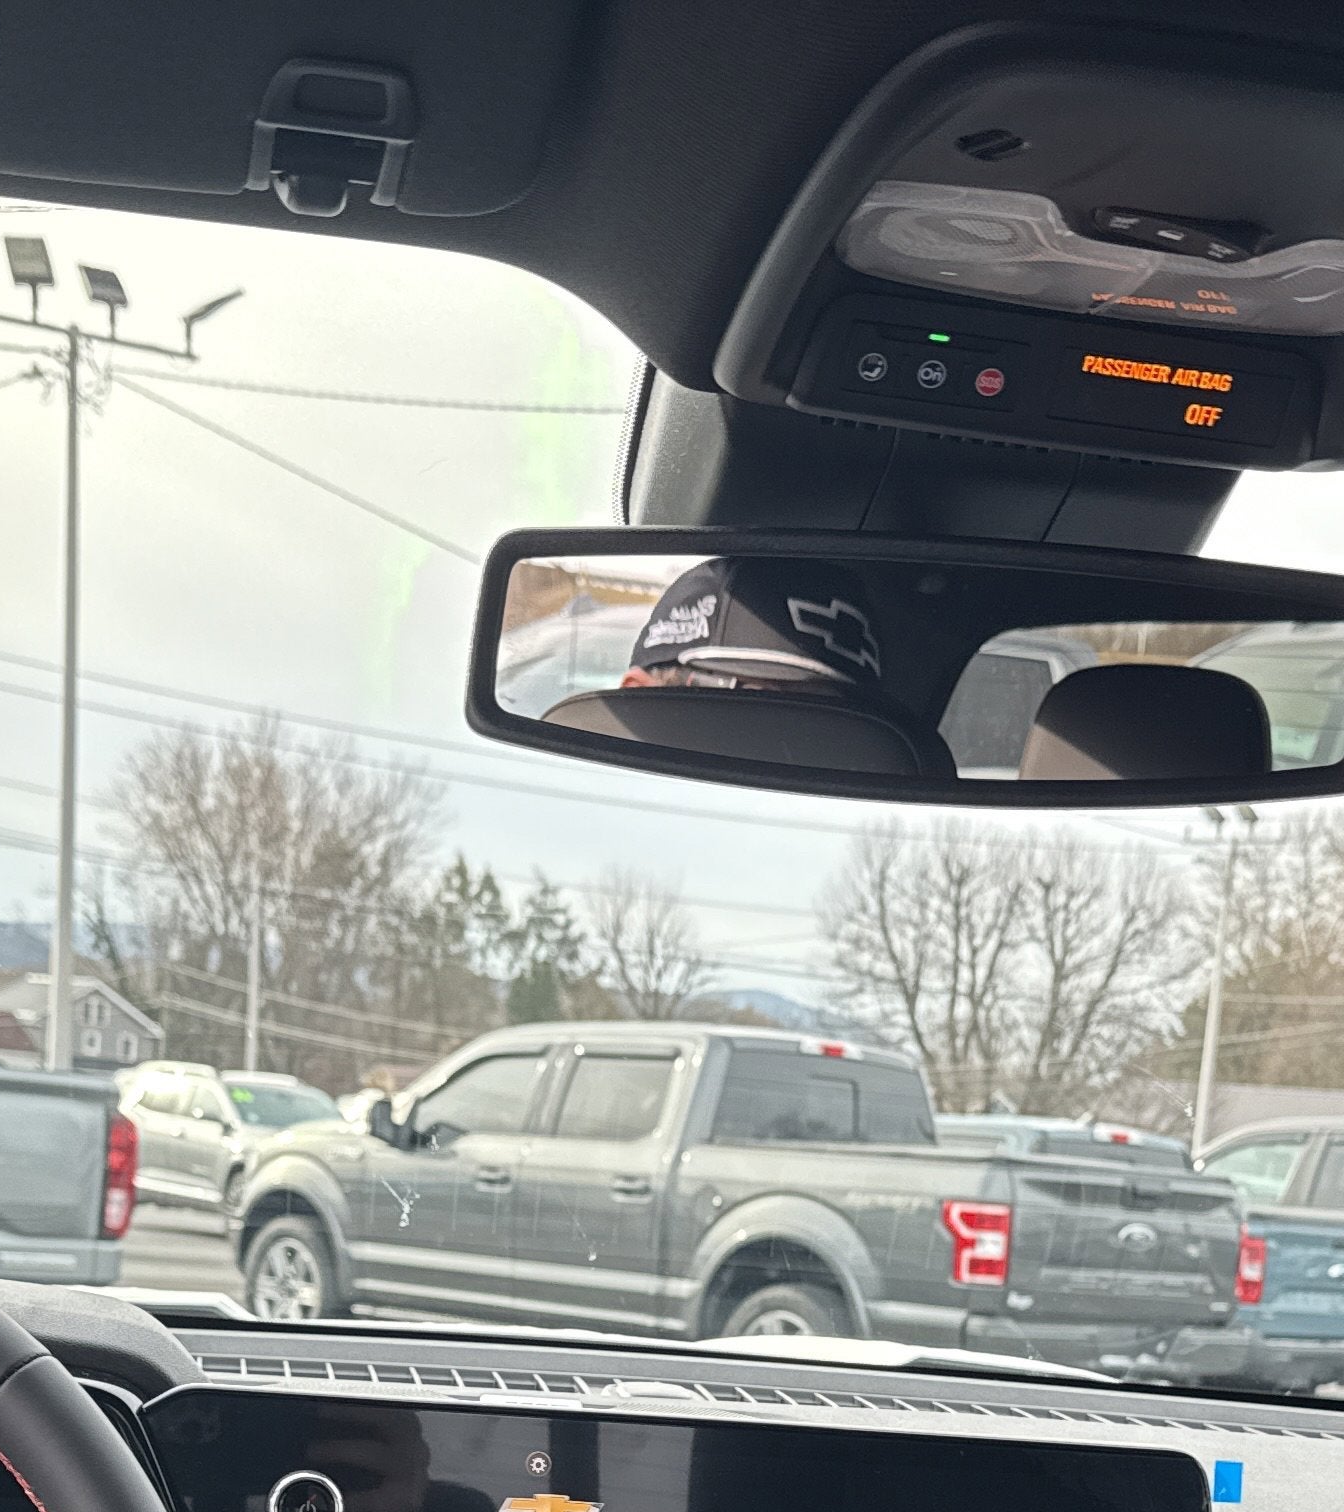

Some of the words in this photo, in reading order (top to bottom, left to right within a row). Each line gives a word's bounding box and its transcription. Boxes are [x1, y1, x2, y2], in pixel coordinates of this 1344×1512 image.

[1081, 355, 1171, 384] PASSENGER
[979, 376, 1002, 388] SOS
[1184, 403, 1223, 427] OFF
